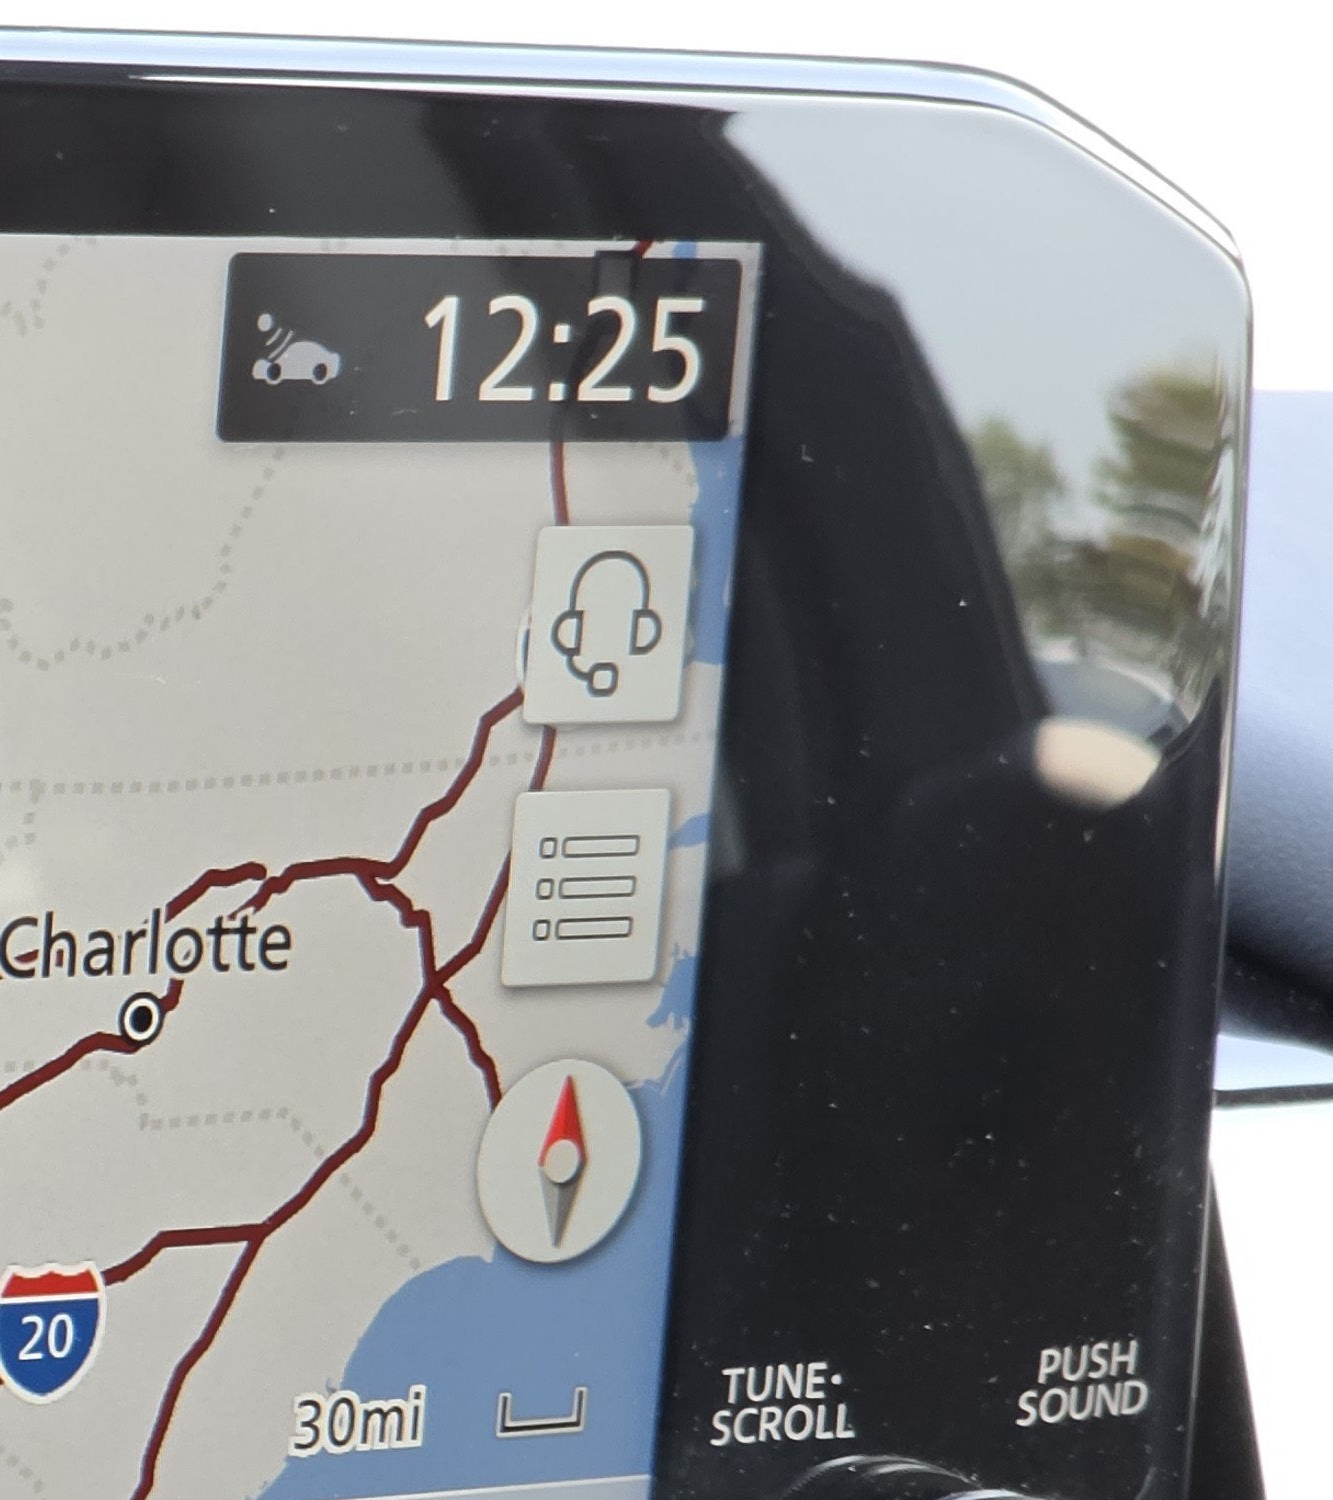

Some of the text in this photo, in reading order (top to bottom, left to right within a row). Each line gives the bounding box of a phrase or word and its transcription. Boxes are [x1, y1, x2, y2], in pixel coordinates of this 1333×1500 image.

[423, 295, 706, 403] 12:25
[17, 1313, 75, 1361] 20
[1036, 1339, 1139, 1385] PUSH
[291, 1386, 424, 1452] 30mi
[709, 1402, 856, 1447] SCROLL
[1015, 1378, 1149, 1428] SOUND
